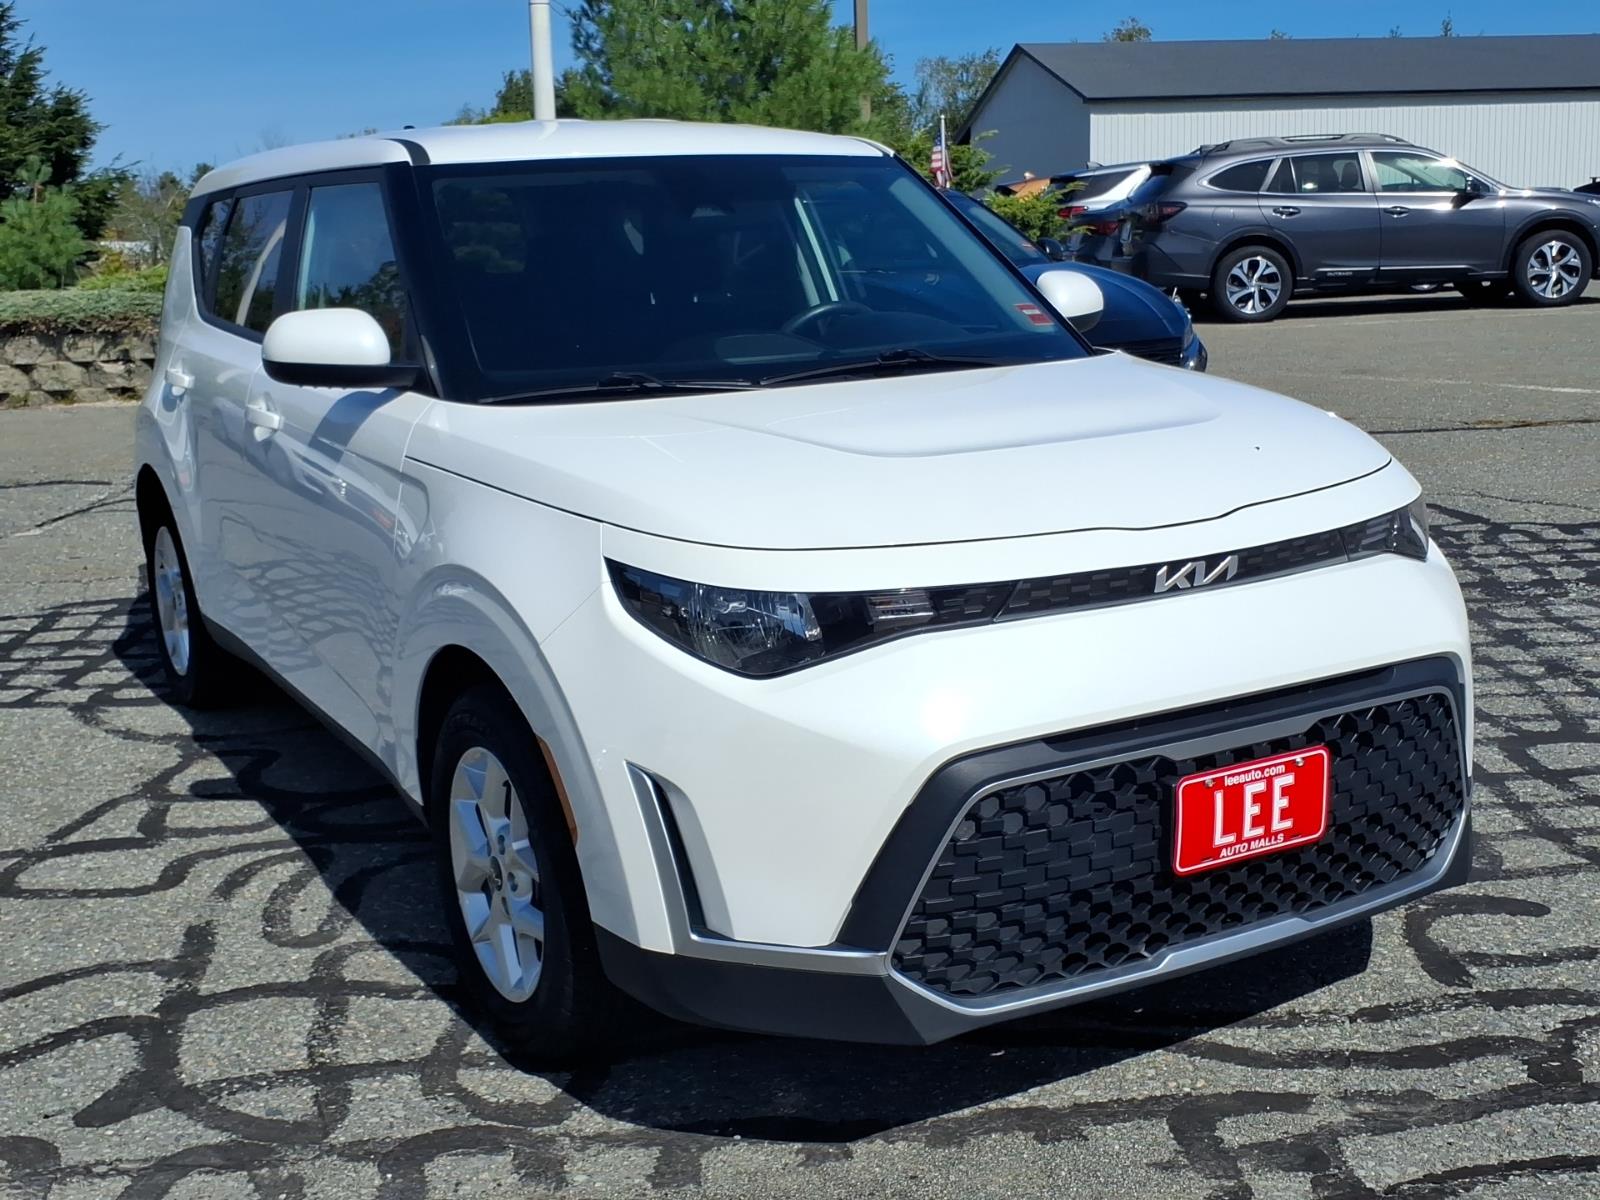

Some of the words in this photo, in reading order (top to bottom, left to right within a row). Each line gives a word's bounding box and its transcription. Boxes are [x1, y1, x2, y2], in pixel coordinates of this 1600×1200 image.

[1153, 555, 1239, 593] KIA
[1224, 764, 1286, 787] leeauto.com
[1213, 772, 1296, 848] LEE
[1219, 843, 1249, 859] AUTO
[1249, 833, 1285, 850] MALLS
